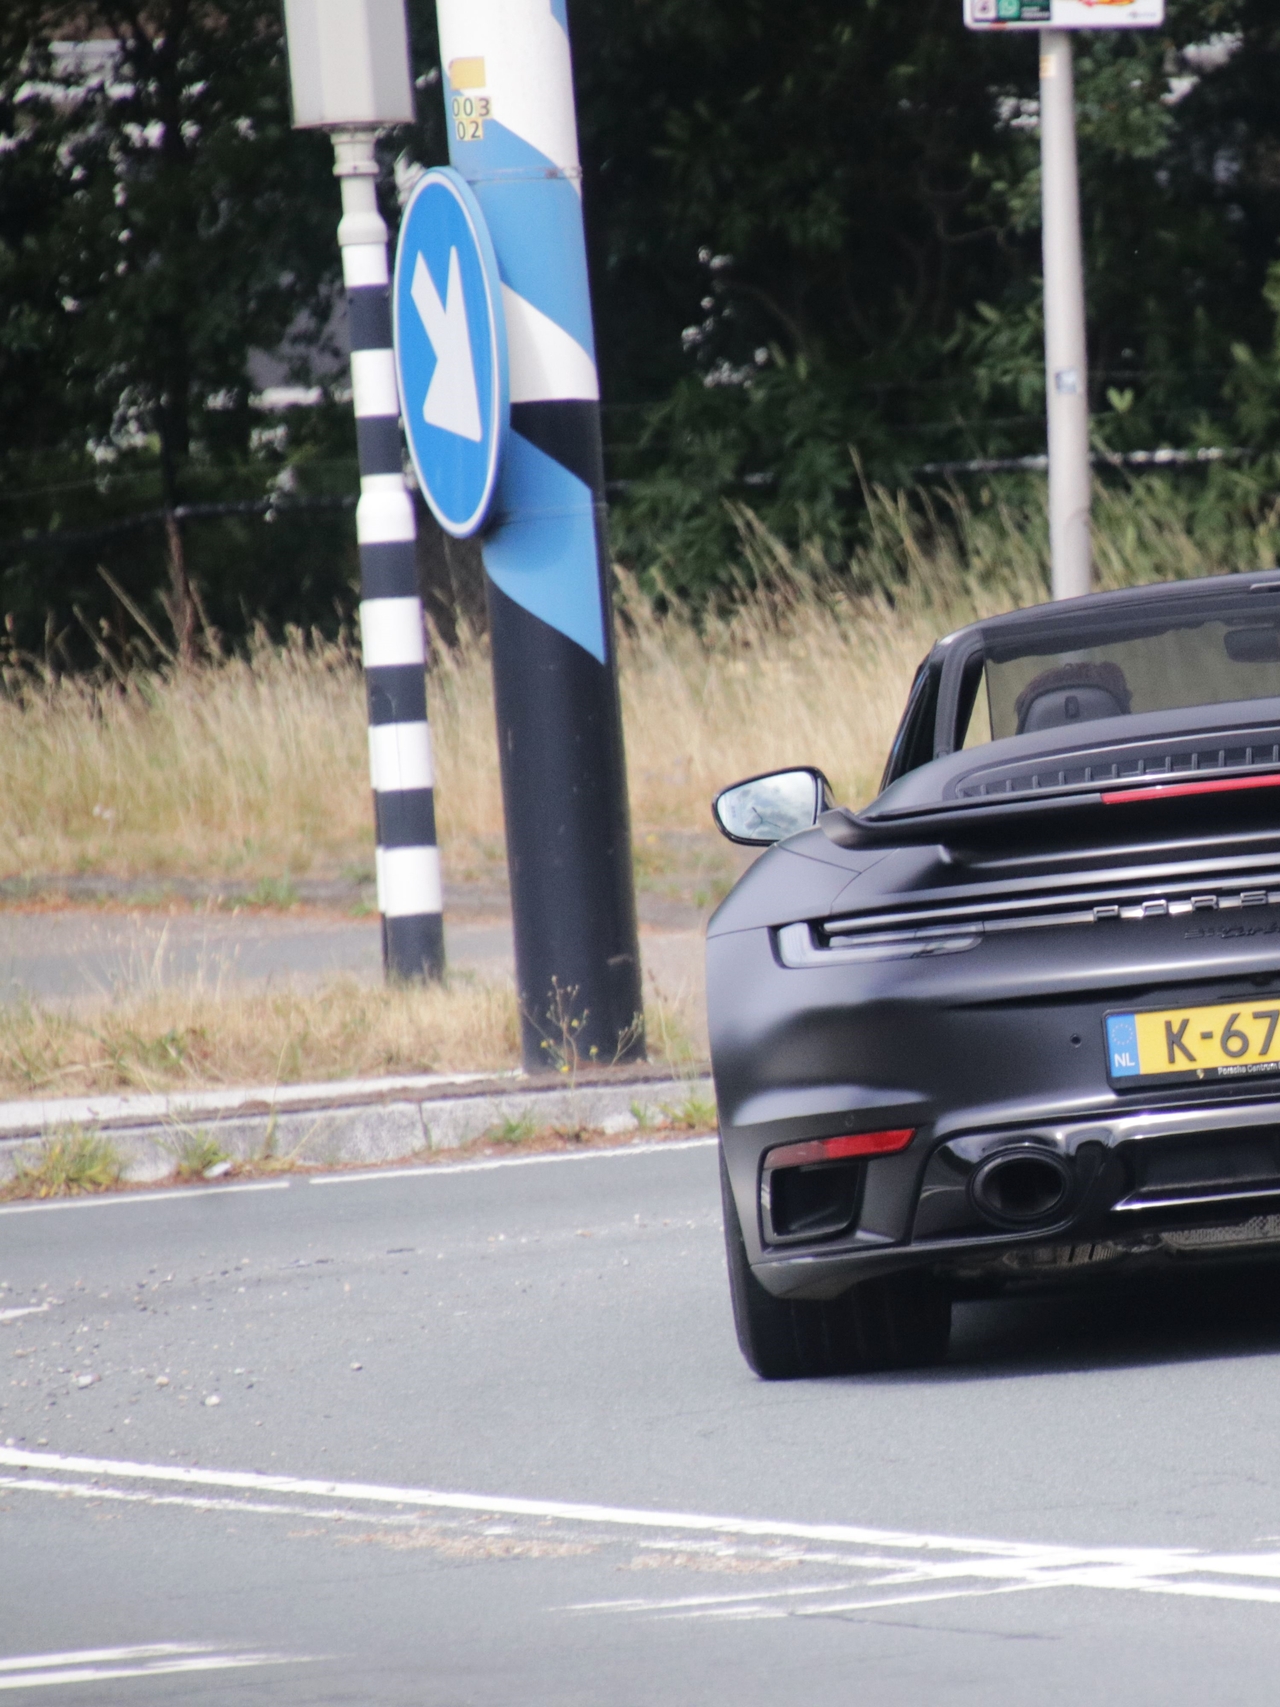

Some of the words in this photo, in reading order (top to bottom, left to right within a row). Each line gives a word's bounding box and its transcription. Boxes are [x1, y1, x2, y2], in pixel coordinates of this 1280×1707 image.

[452, 97, 491, 117] 003
[457, 121, 481, 140] 02
[1114, 1053, 1135, 1068] NL
[1217, 1065, 1247, 1076] Porsche
[1247, 1062, 1278, 1073] Centrum
